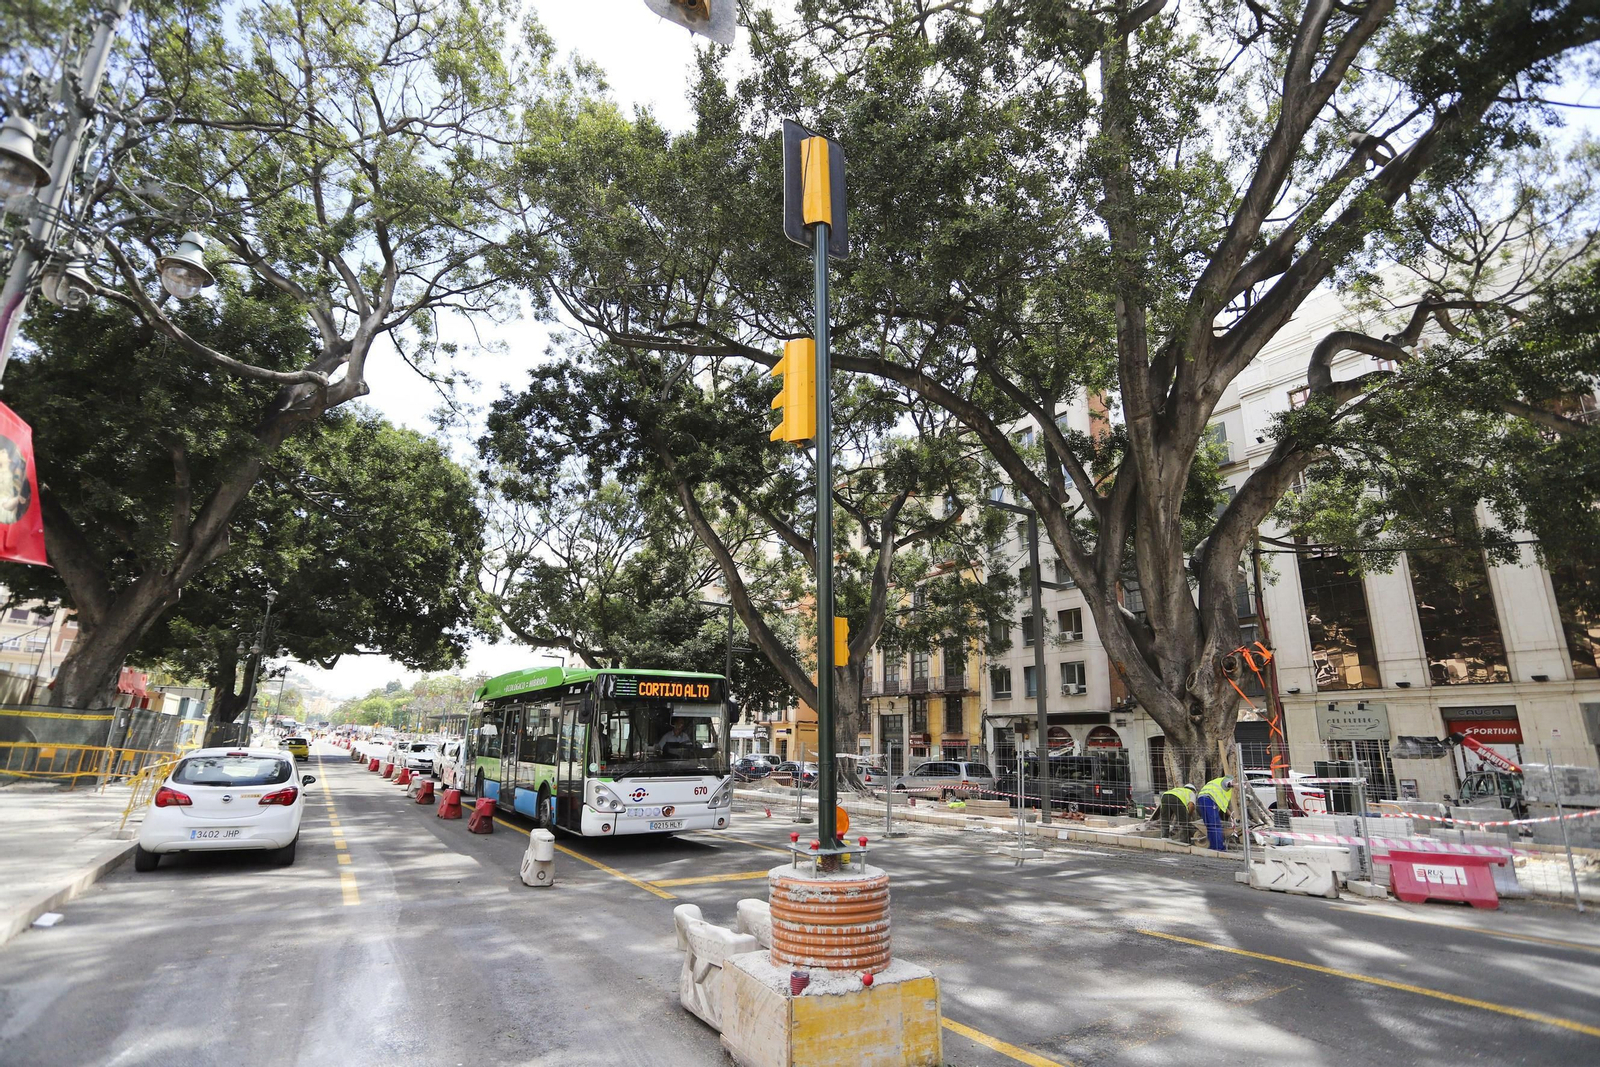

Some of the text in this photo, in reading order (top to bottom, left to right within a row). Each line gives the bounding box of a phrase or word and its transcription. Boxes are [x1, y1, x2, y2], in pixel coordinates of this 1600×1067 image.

[638, 682, 683, 697] CORTIJO
[684, 684, 710, 698] ALTO
[1462, 726, 1517, 736] SPORTIUM
[1476, 747, 1512, 771] MANITO
[694, 786, 708, 796] 670
[653, 821, 669, 829] 0215
[196, 829, 240, 839] 3402 JHP
